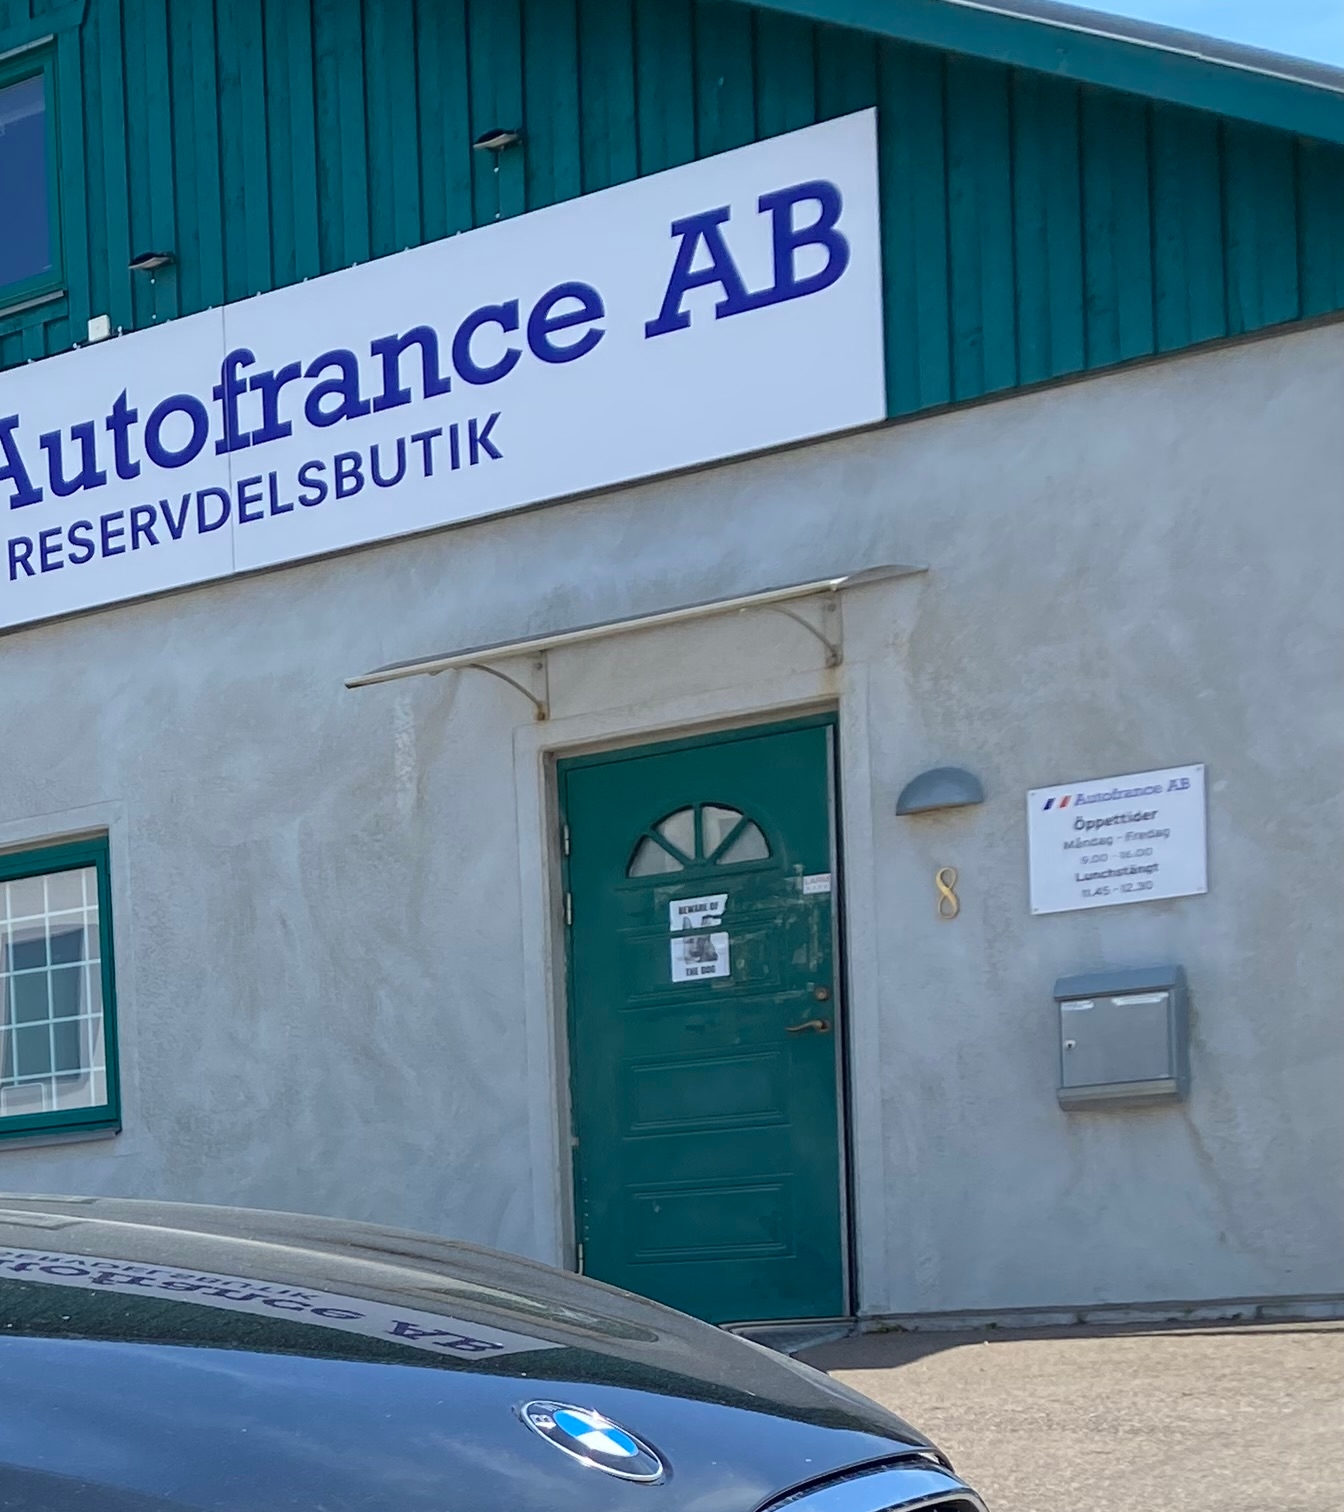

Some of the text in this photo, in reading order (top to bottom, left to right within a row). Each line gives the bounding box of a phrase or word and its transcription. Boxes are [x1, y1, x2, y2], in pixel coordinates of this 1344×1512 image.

[644, 179, 851, 340] AB
[7, 411, 504, 582] RESERVDELSBUTIK
[1074, 777, 1192, 807] Autofrance AB
[1073, 810, 1158, 831] Öppettider
[935, 867, 959, 919] 8
